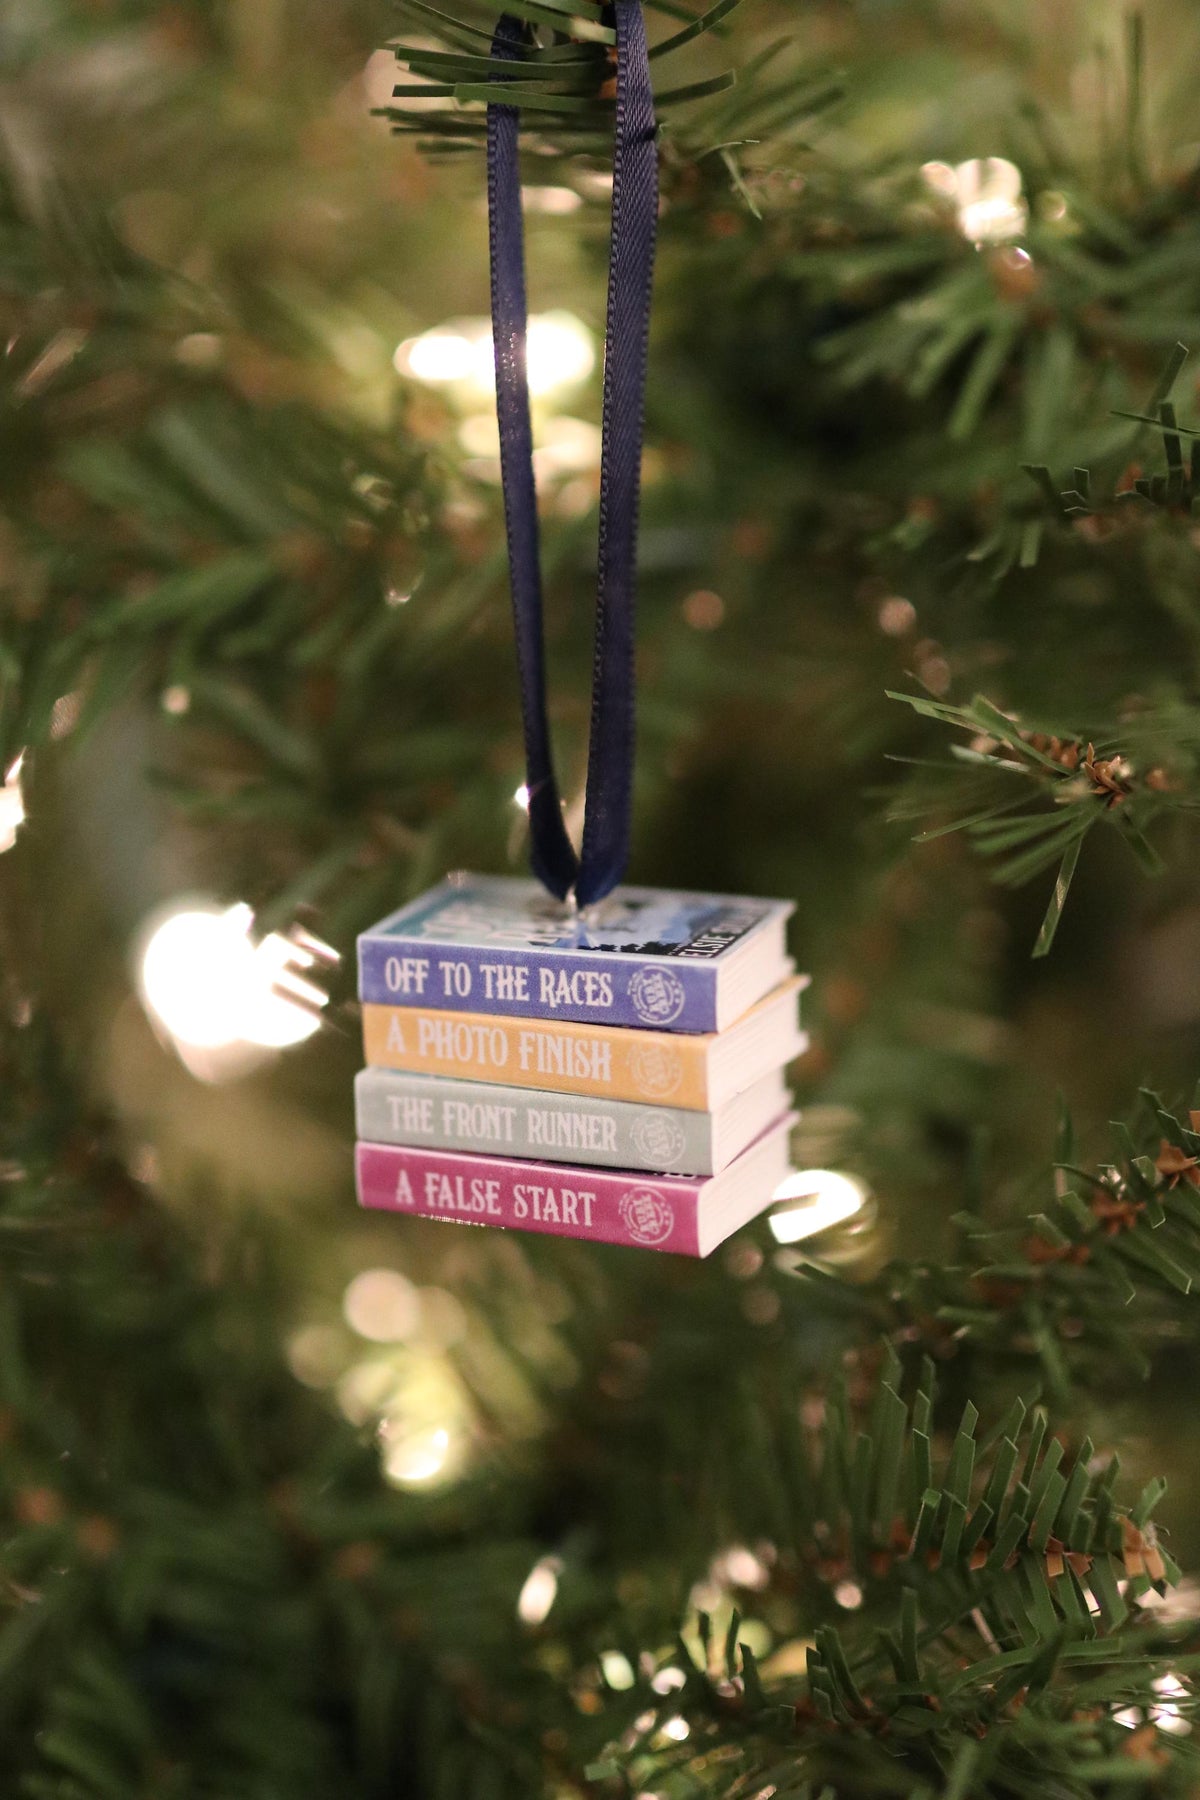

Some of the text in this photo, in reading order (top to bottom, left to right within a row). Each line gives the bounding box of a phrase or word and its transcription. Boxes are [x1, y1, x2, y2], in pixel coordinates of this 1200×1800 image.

[678, 934, 736, 958] ELSIE
[385, 957, 429, 995] OFF
[439, 961, 472, 997] TO
[480, 964, 529, 1002] THE
[540, 967, 613, 1008] RACES
[387, 1015, 405, 1052] A
[418, 1017, 507, 1066] PHOTO
[519, 1031, 612, 1081] FINISH
[389, 1095, 434, 1133] THE
[443, 1100, 516, 1142] FRONT
[528, 1109, 618, 1152] RUNNER
[396, 1170, 412, 1203] A
[425, 1173, 501, 1214] FALSE
[513, 1184, 596, 1227] START
